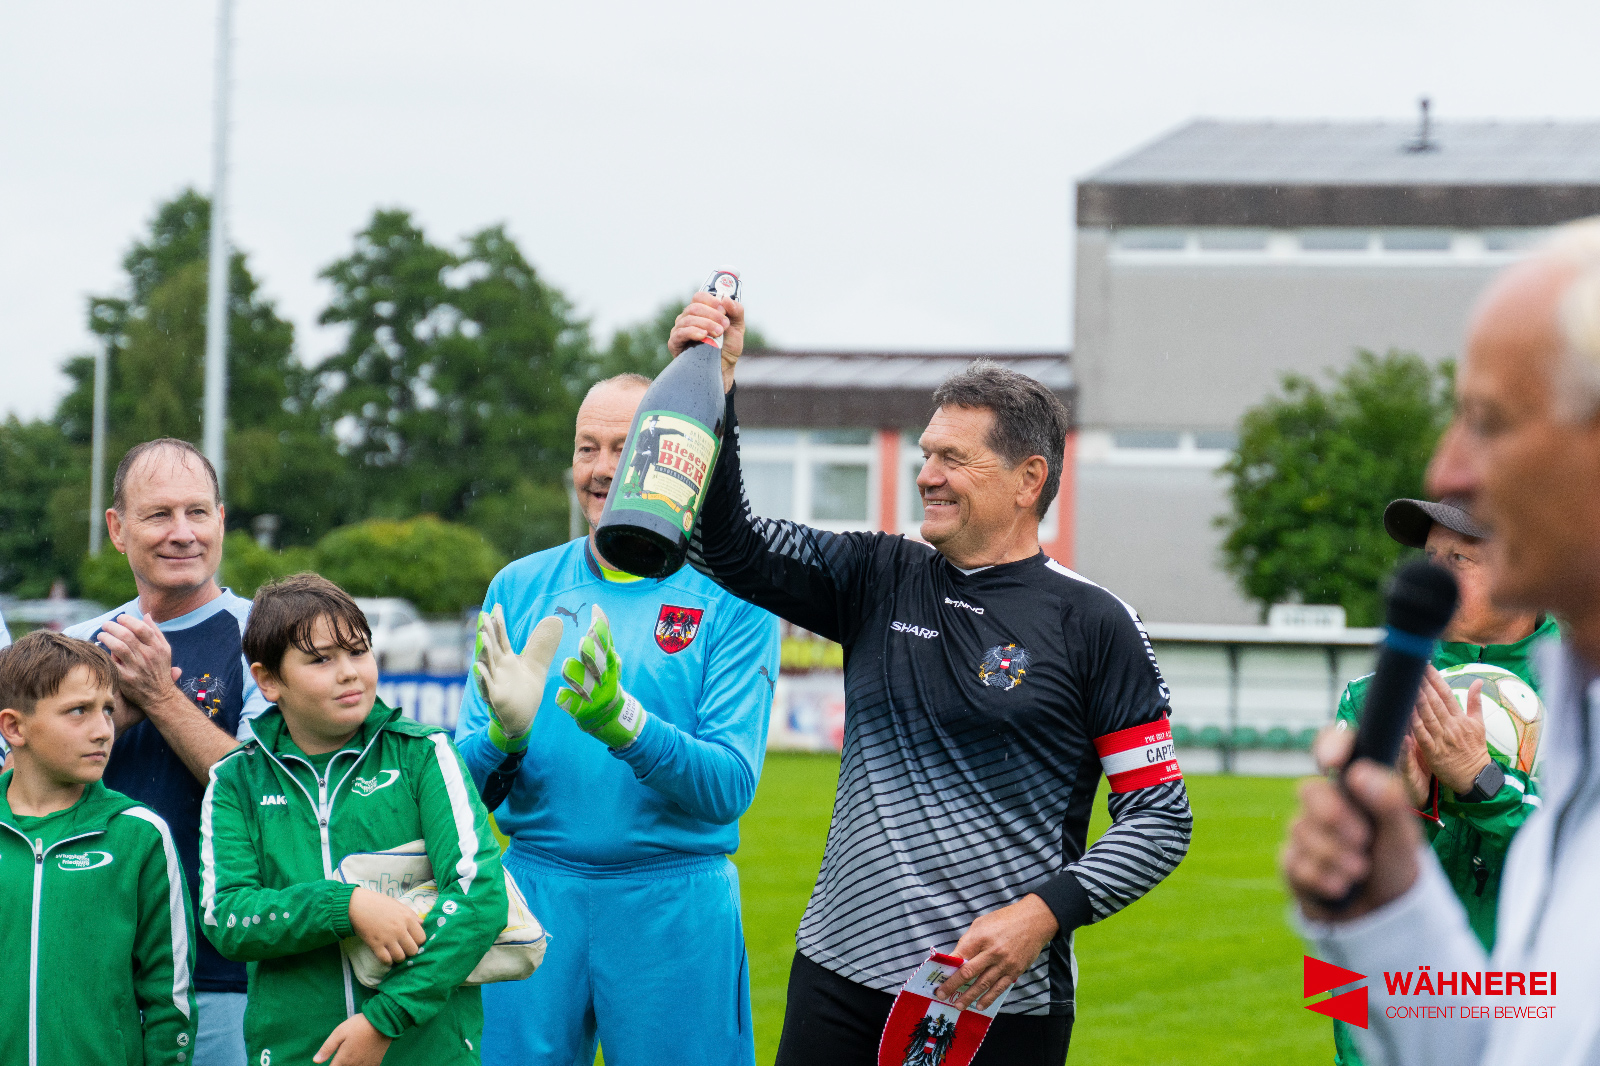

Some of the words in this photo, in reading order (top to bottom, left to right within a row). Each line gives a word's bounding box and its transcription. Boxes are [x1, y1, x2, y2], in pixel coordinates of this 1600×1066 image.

[661, 440, 707, 473] Riesen
[658, 451, 704, 487] BIER
[890, 621, 939, 639] SHARP
[260, 795, 288, 805] JAK
[260, 1048, 271, 1066] 6
